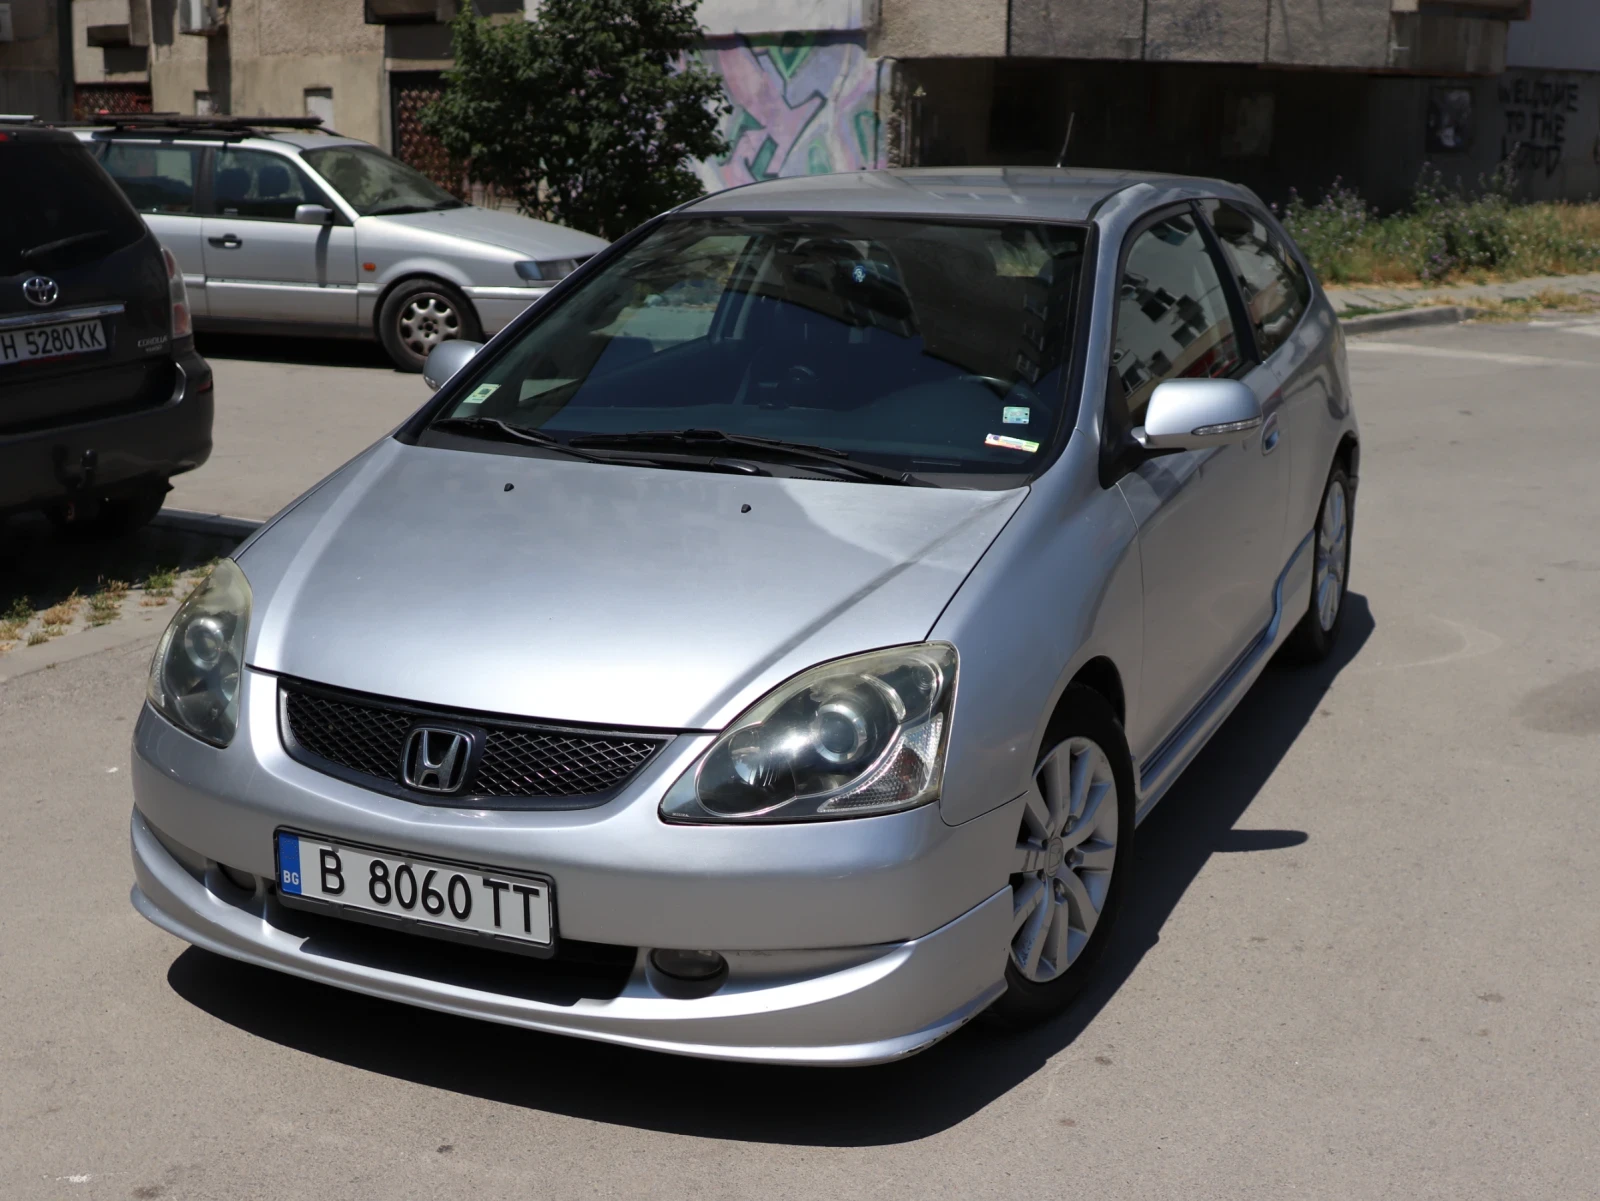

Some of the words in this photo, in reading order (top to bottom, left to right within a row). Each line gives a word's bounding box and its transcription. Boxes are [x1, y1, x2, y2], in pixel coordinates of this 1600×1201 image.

[1530, 113, 1565, 143] THE
[25, 327, 74, 355] 5280
[283, 870, 299, 885] BG
[319, 848, 345, 895] B
[368, 859, 473, 920] 8060
[482, 878, 540, 934] TT
